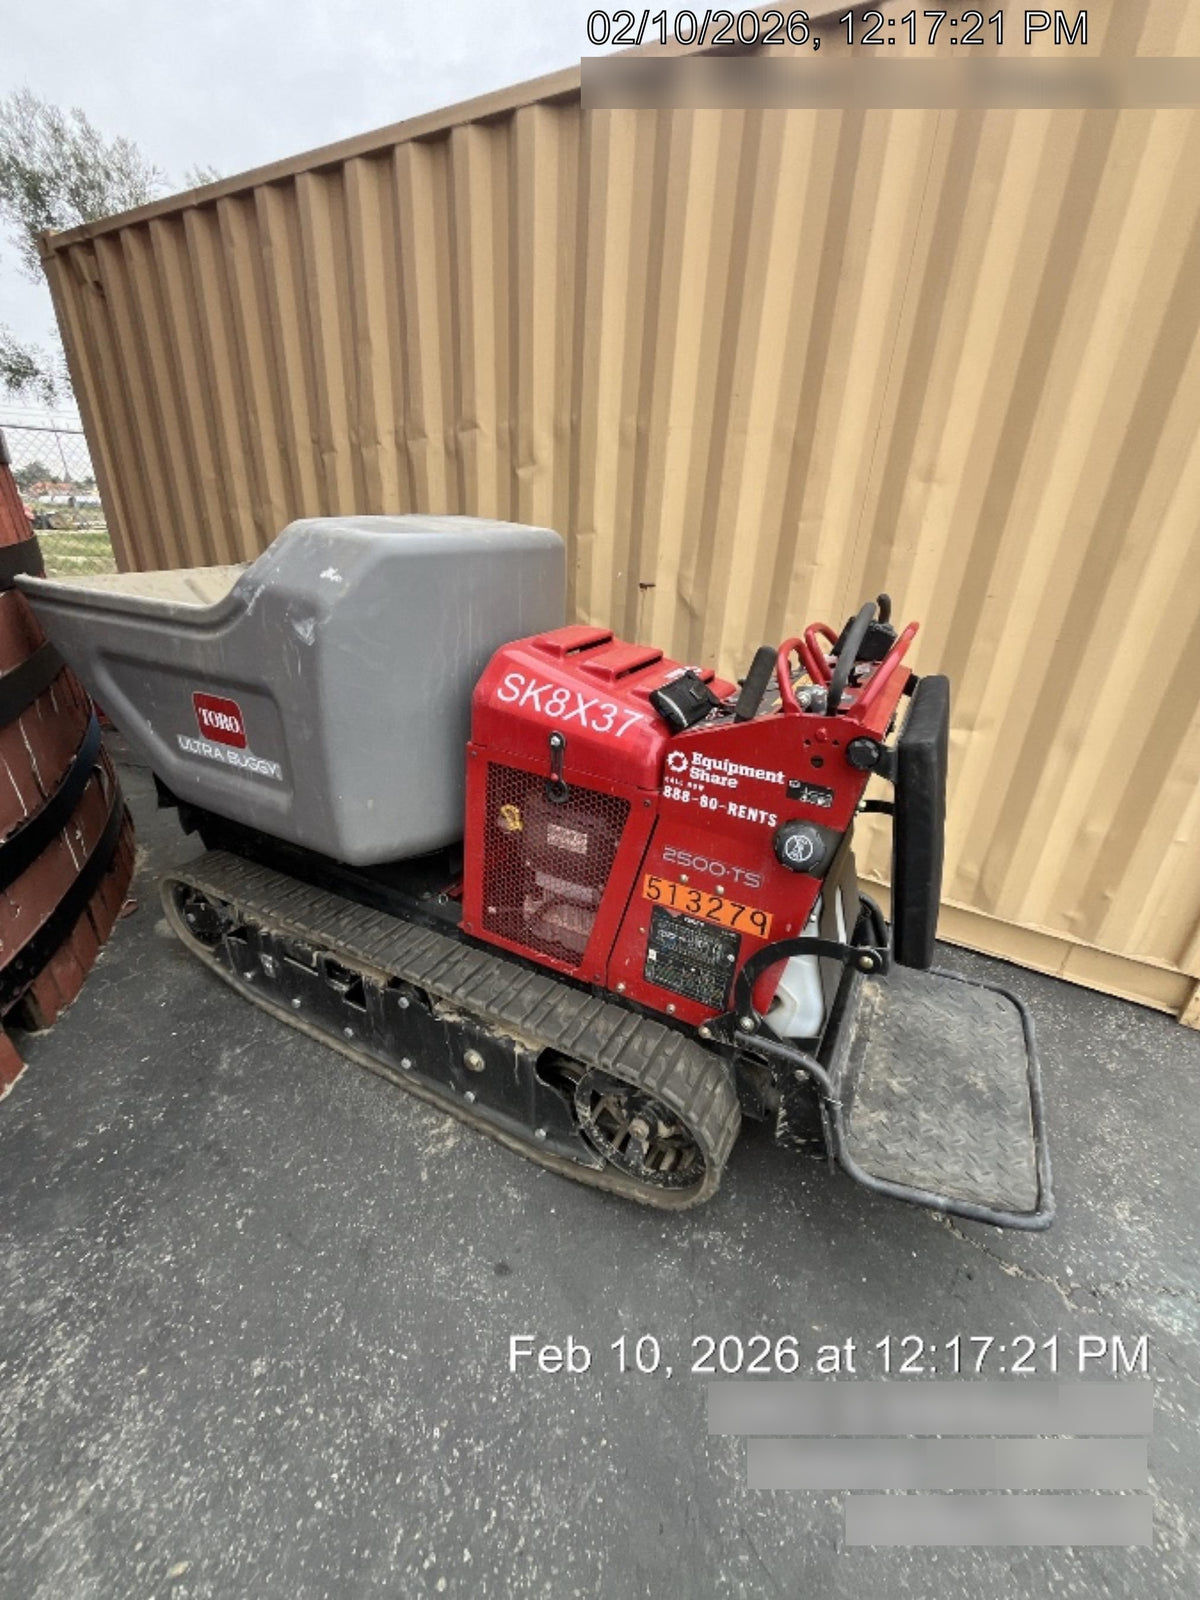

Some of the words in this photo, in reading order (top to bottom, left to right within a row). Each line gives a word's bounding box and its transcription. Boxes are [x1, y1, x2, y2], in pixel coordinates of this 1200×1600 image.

[199, 707, 240, 733] TORO
[497, 673, 644, 737] SK8X37
[177, 736, 224, 761] ULTRA
[226, 751, 278, 776] BUGGY
[691, 751, 785, 785] Equipment
[689, 766, 739, 789] Share
[662, 785, 778, 827] 888-80-RENTS
[646, 877, 767, 935] 513279
